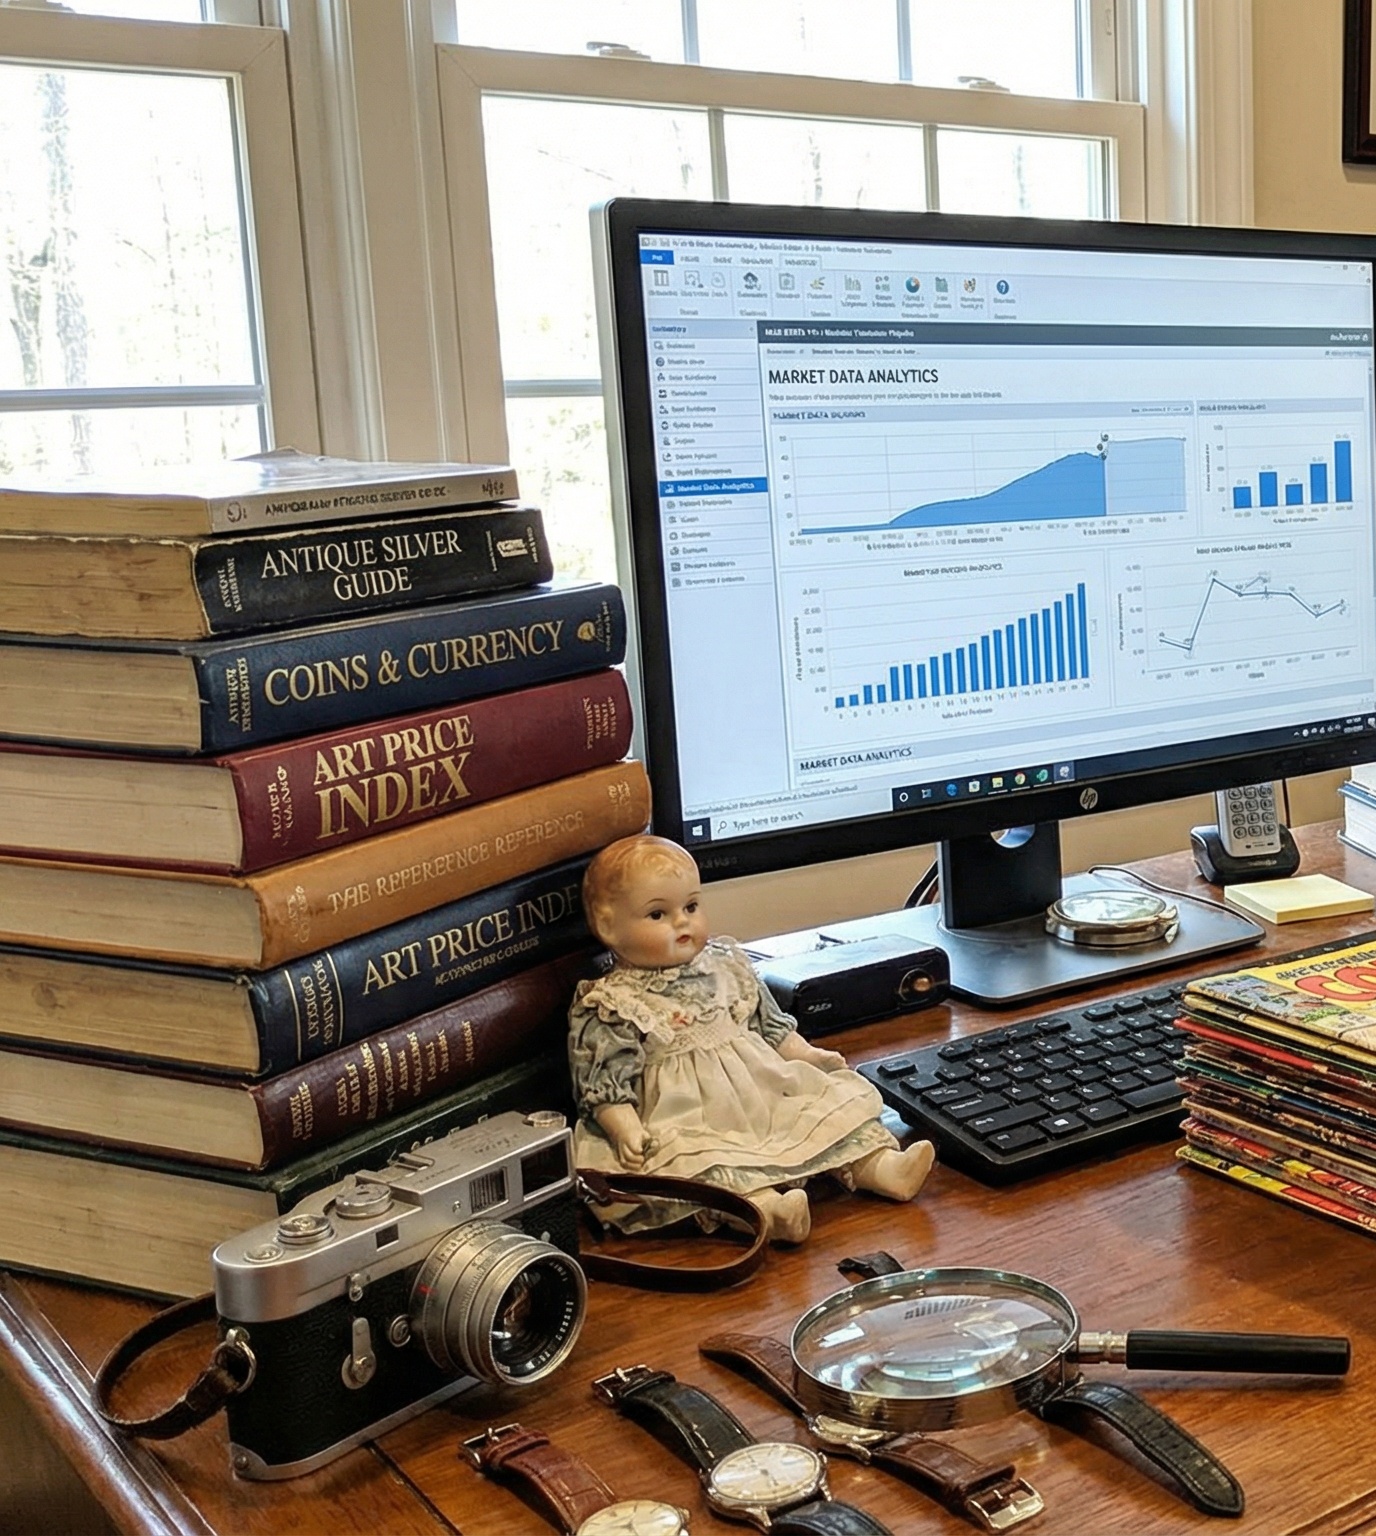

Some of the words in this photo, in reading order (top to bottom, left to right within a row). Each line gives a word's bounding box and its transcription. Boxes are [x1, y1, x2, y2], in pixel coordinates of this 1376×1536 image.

[768, 369, 826, 385] MARKET
[829, 369, 865, 384] DATA
[867, 368, 939, 384] ANALYTICS
[261, 538, 375, 579] ANTIQUE
[381, 529, 463, 564] SILVER
[333, 566, 412, 601] GUIDE
[264, 654, 371, 706] COINS
[378, 650, 402, 686] &
[408, 619, 564, 679] CURRENCY
[314, 738, 376, 786] ART
[381, 714, 475, 767] PRICE
[314, 751, 473, 841] INDEX
[363, 941, 422, 996] ART
[427, 909, 514, 968] PRICE
